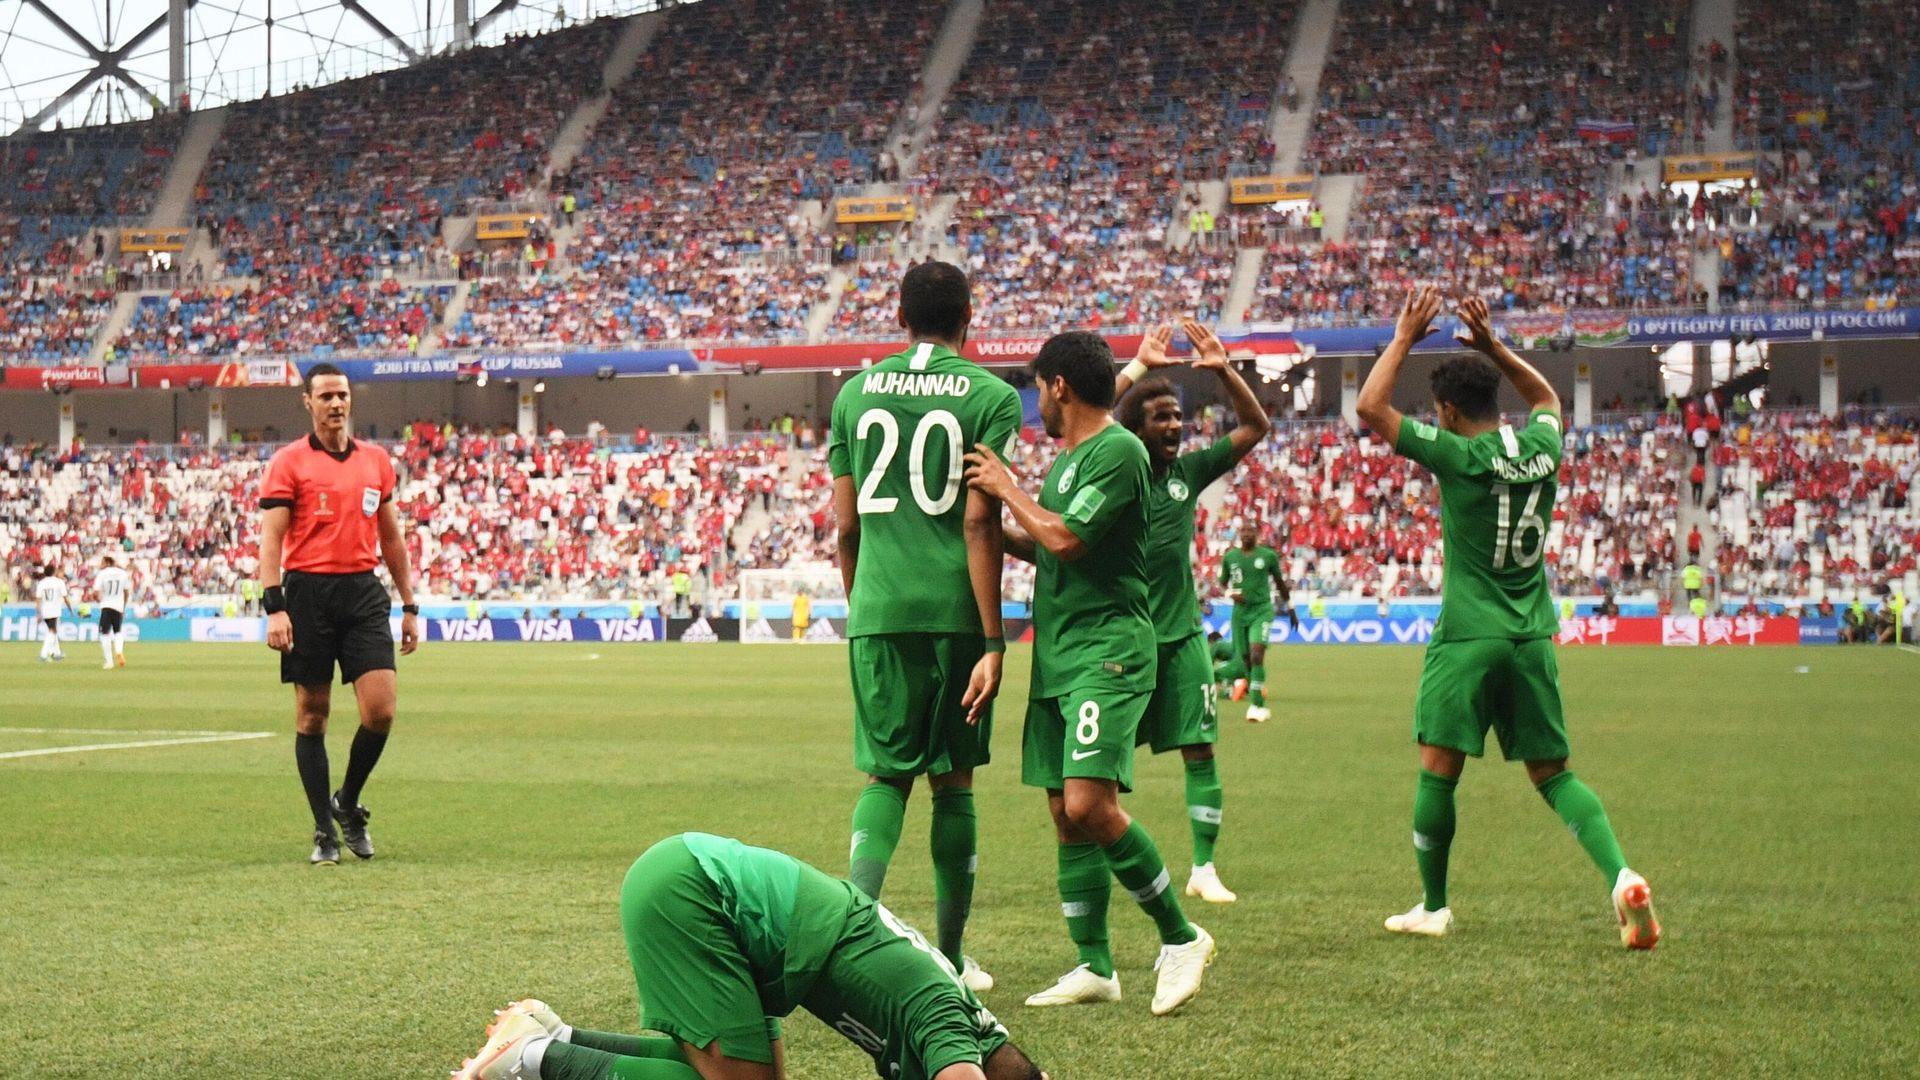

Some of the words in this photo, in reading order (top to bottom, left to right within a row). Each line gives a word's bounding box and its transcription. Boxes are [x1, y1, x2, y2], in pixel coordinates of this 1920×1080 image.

[862, 372, 971, 397] MUHANNAD
[857, 408, 964, 516] 20
[1491, 453, 1555, 481] HUSSAIN
[1490, 482, 1546, 570] 16
[436, 619, 495, 641] VISA
[514, 619, 574, 641] VISA
[594, 619, 655, 641] VISA
[1076, 700, 1100, 745] 8
